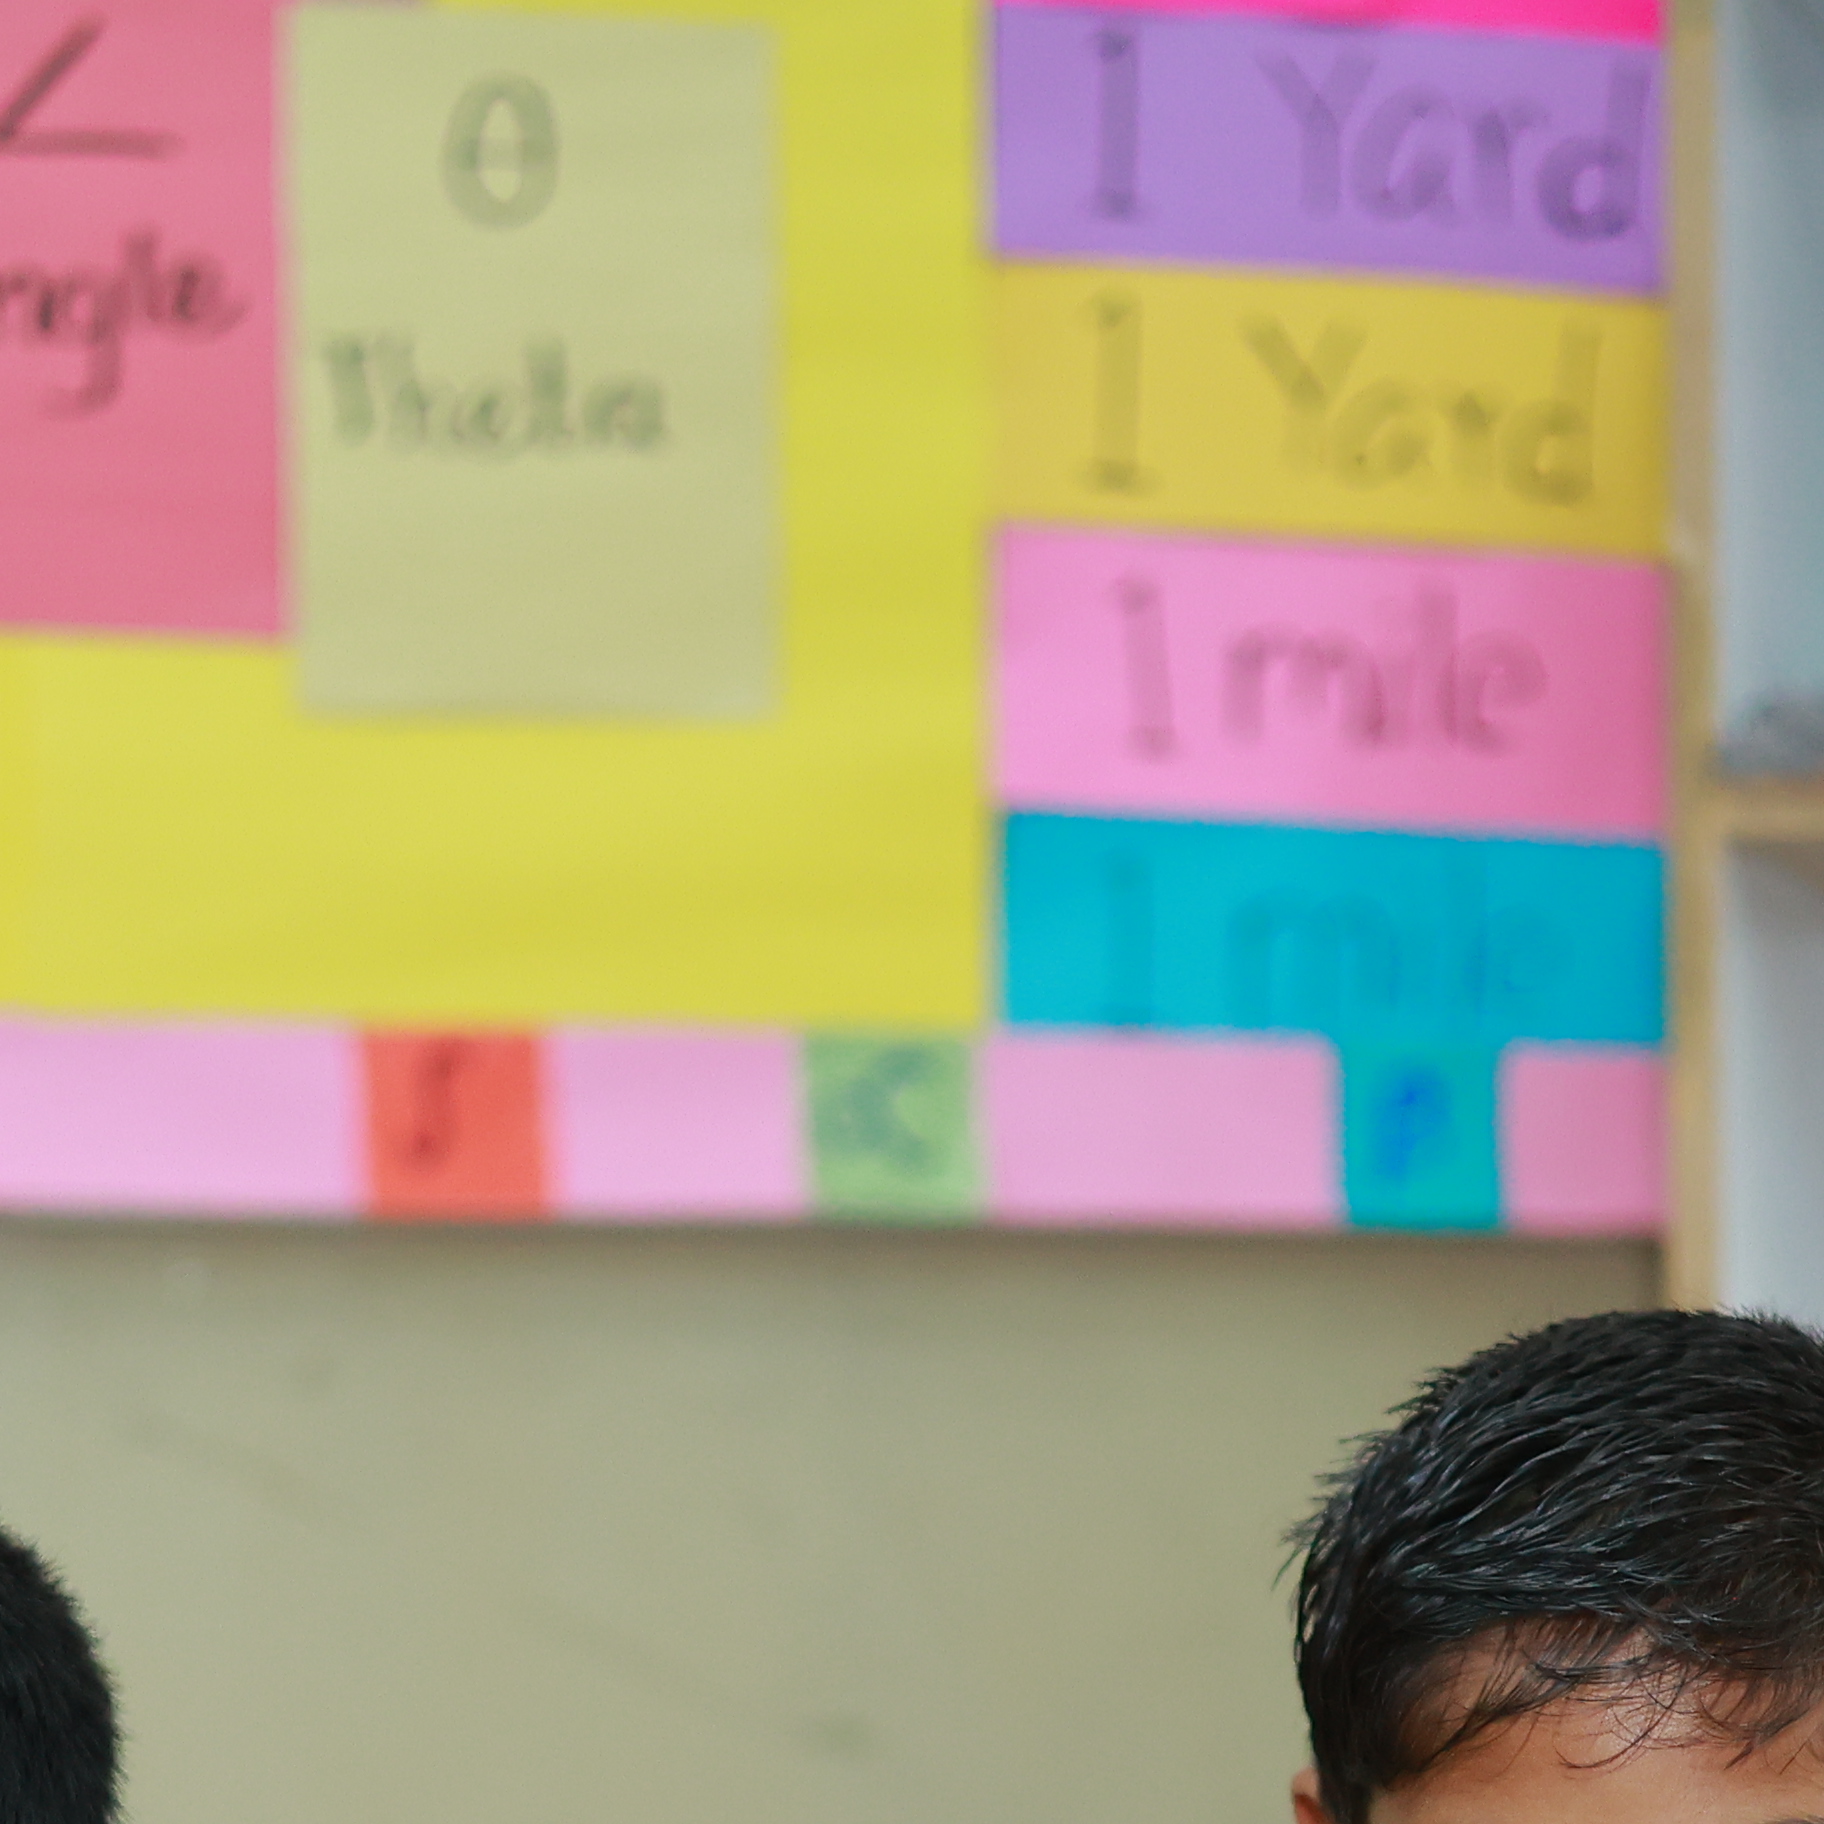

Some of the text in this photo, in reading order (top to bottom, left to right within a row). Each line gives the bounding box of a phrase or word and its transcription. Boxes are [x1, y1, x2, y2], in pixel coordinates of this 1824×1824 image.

[1256, 45, 1651, 243] Yard
[318, 328, 673, 462] Theta
[1076, 288, 1603, 508] 1 Yard
[1112, 568, 1550, 764] 1 mile
